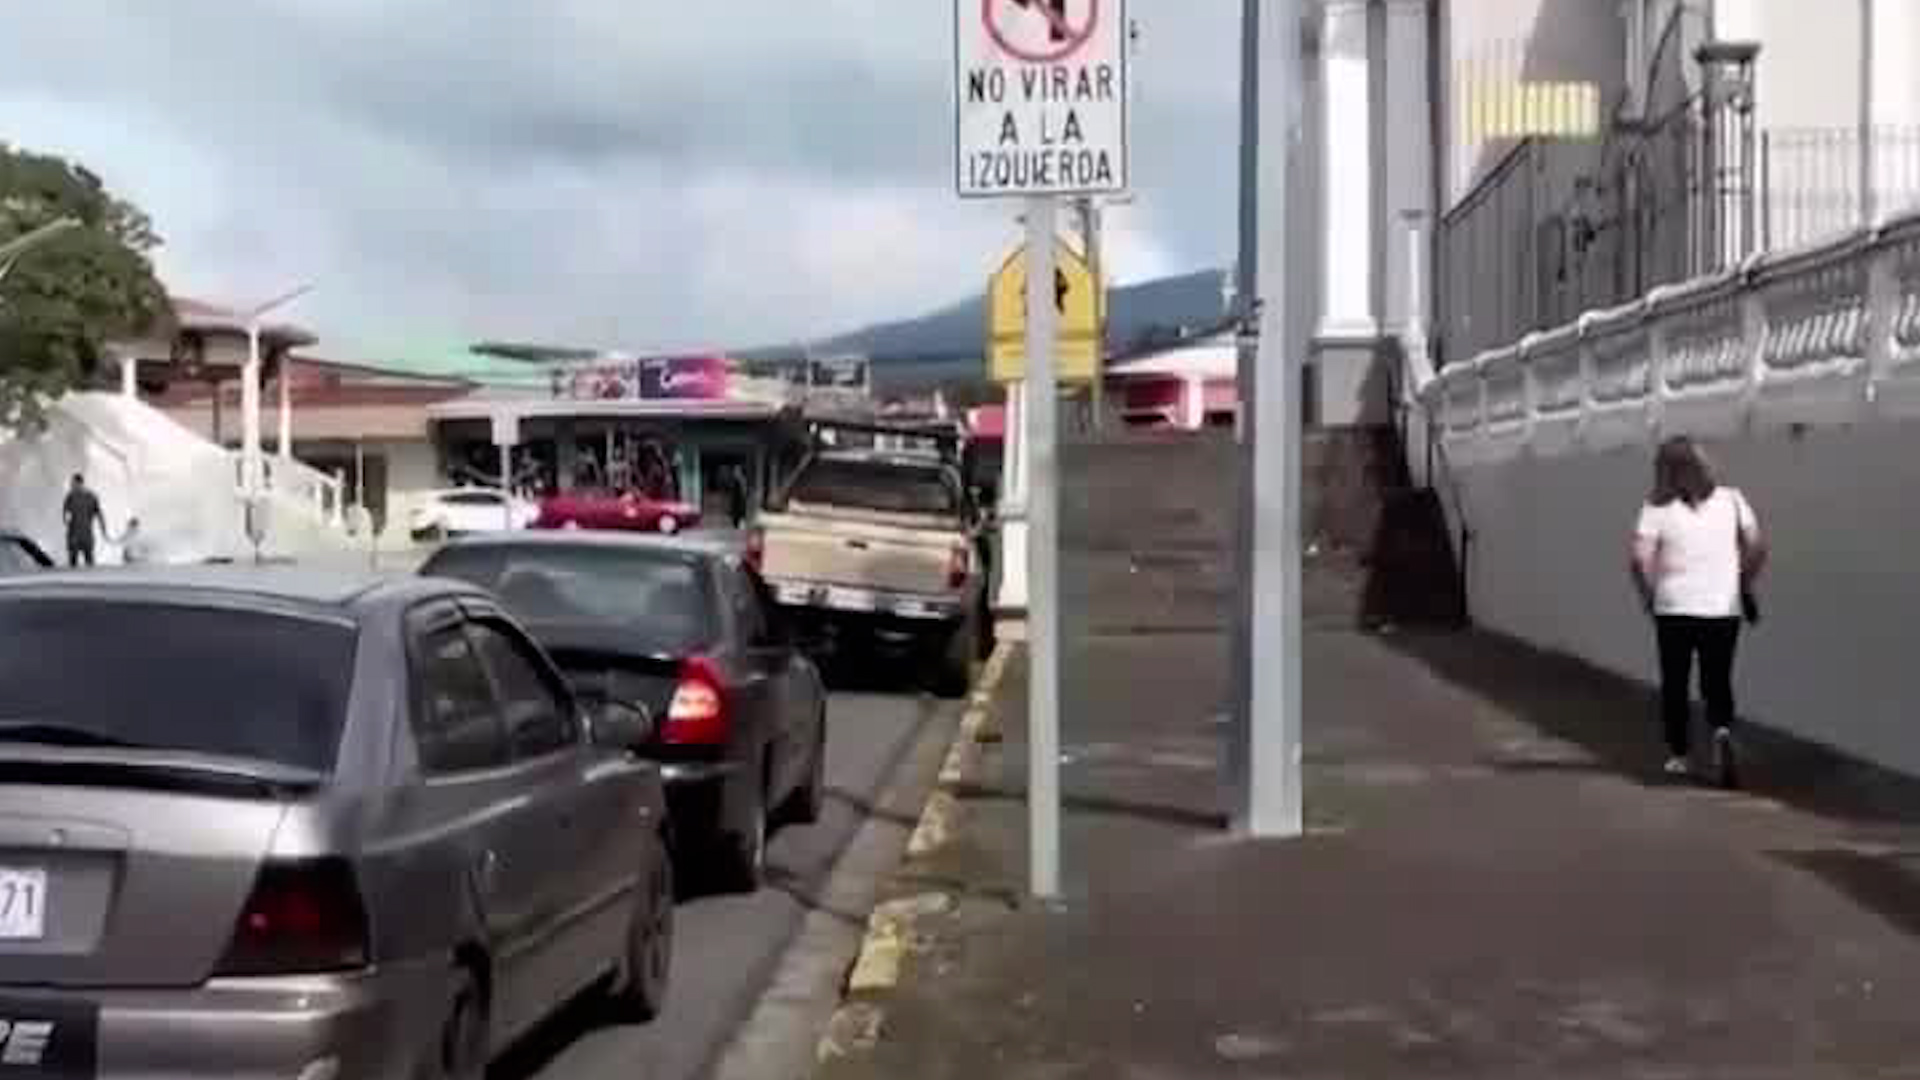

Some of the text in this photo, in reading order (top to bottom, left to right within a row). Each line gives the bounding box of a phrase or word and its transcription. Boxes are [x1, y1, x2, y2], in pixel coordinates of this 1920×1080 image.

[968, 64, 1112, 102] NO VIRAR
[999, 108, 1083, 145] A LA
[969, 149, 1113, 188] IZQUIERDA
